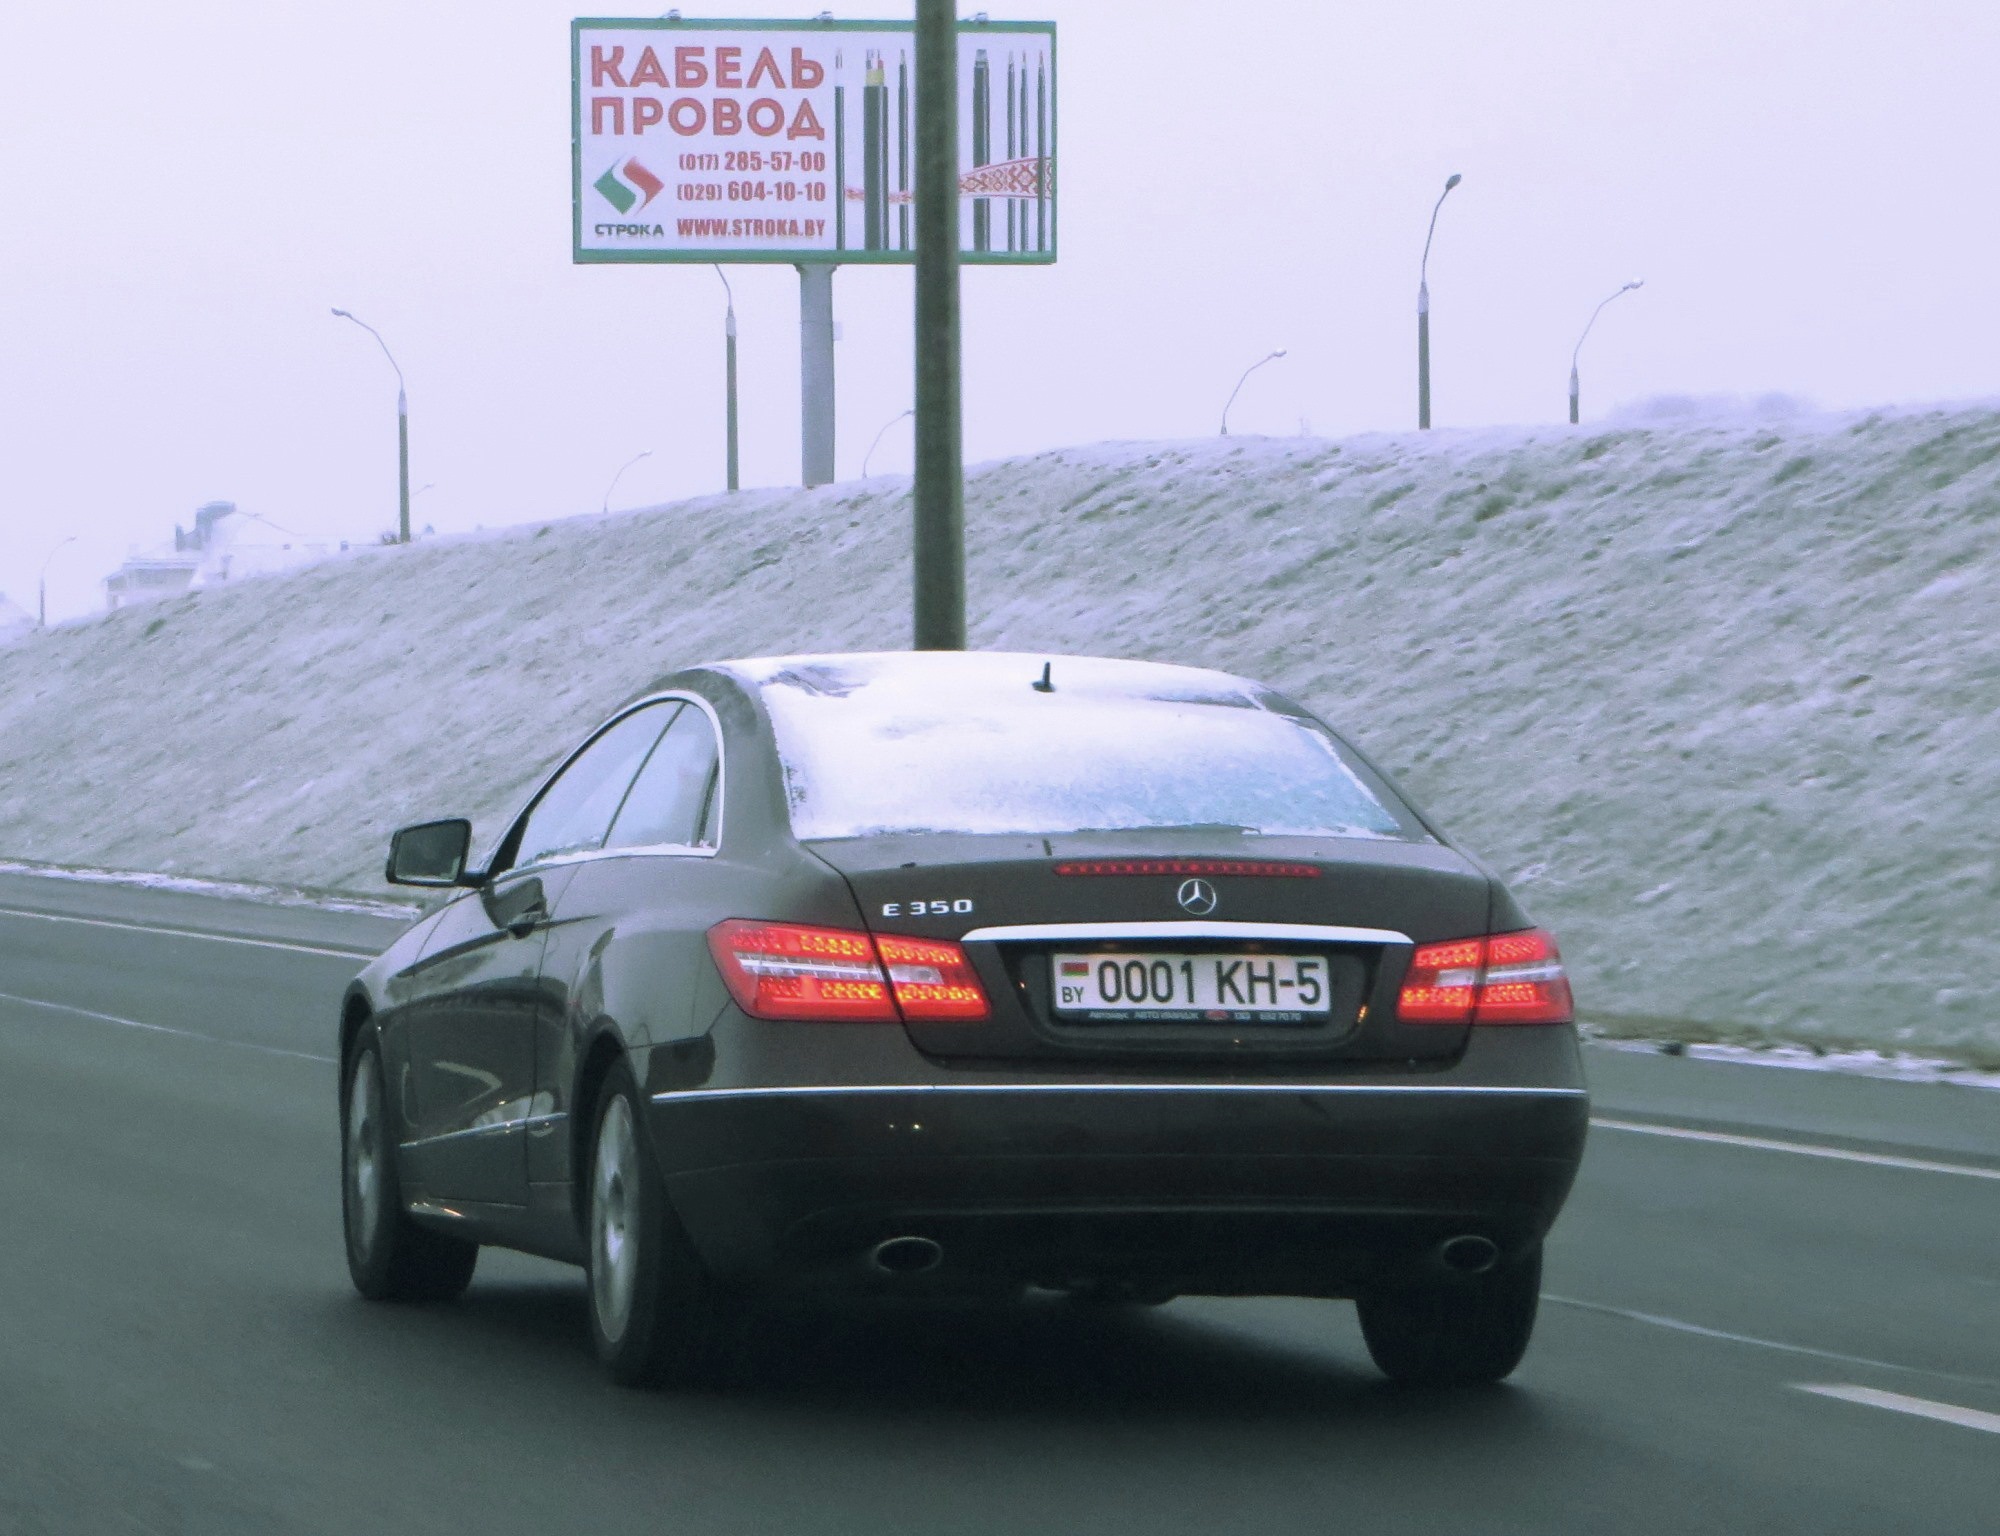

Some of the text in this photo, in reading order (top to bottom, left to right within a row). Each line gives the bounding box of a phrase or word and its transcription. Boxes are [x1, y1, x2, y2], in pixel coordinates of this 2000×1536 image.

[591, 45, 825, 89] КАБЕЛЬ
[591, 97, 825, 141] ПРОВОД
[679, 151, 826, 171] (017) 285-57-00
[677, 181, 826, 201] (029) 604-10-10
[594, 223, 664, 237] СТРОКА
[677, 218, 825, 237] WWW.STROKA.BY
[882, 899, 973, 916] E 350
[1061, 960, 1321, 1005] BY 0001 KH-5
